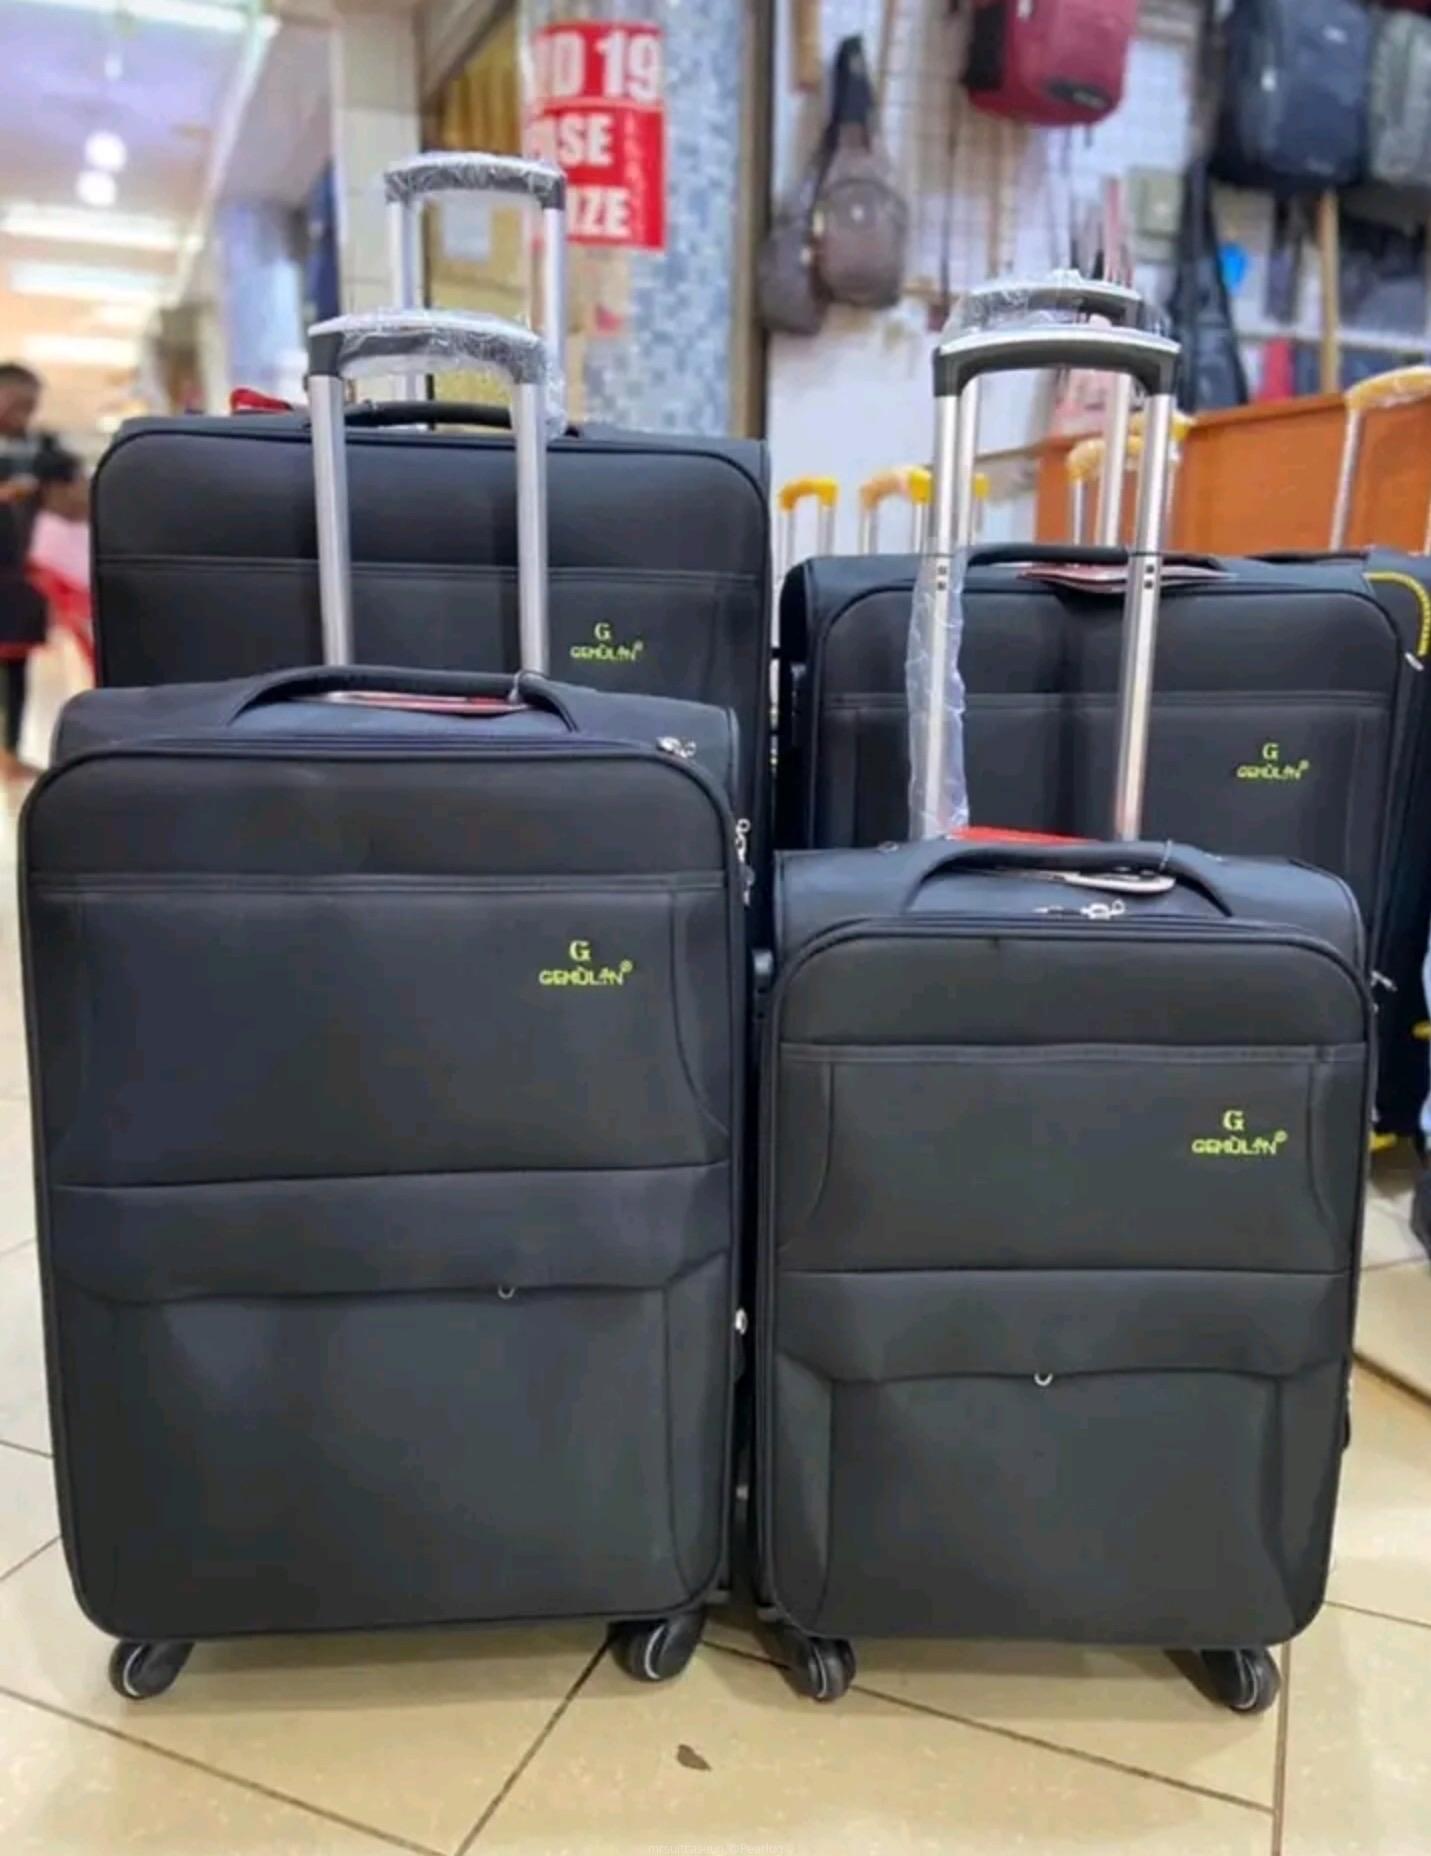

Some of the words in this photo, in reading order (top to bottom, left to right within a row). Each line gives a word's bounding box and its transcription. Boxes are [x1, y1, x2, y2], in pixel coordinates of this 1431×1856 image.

[596, 29, 661, 102] 19
[594, 622, 611, 640] G
[1263, 743, 1279, 760] G
[569, 940, 591, 961] G
[1223, 1109, 1244, 1131] G
